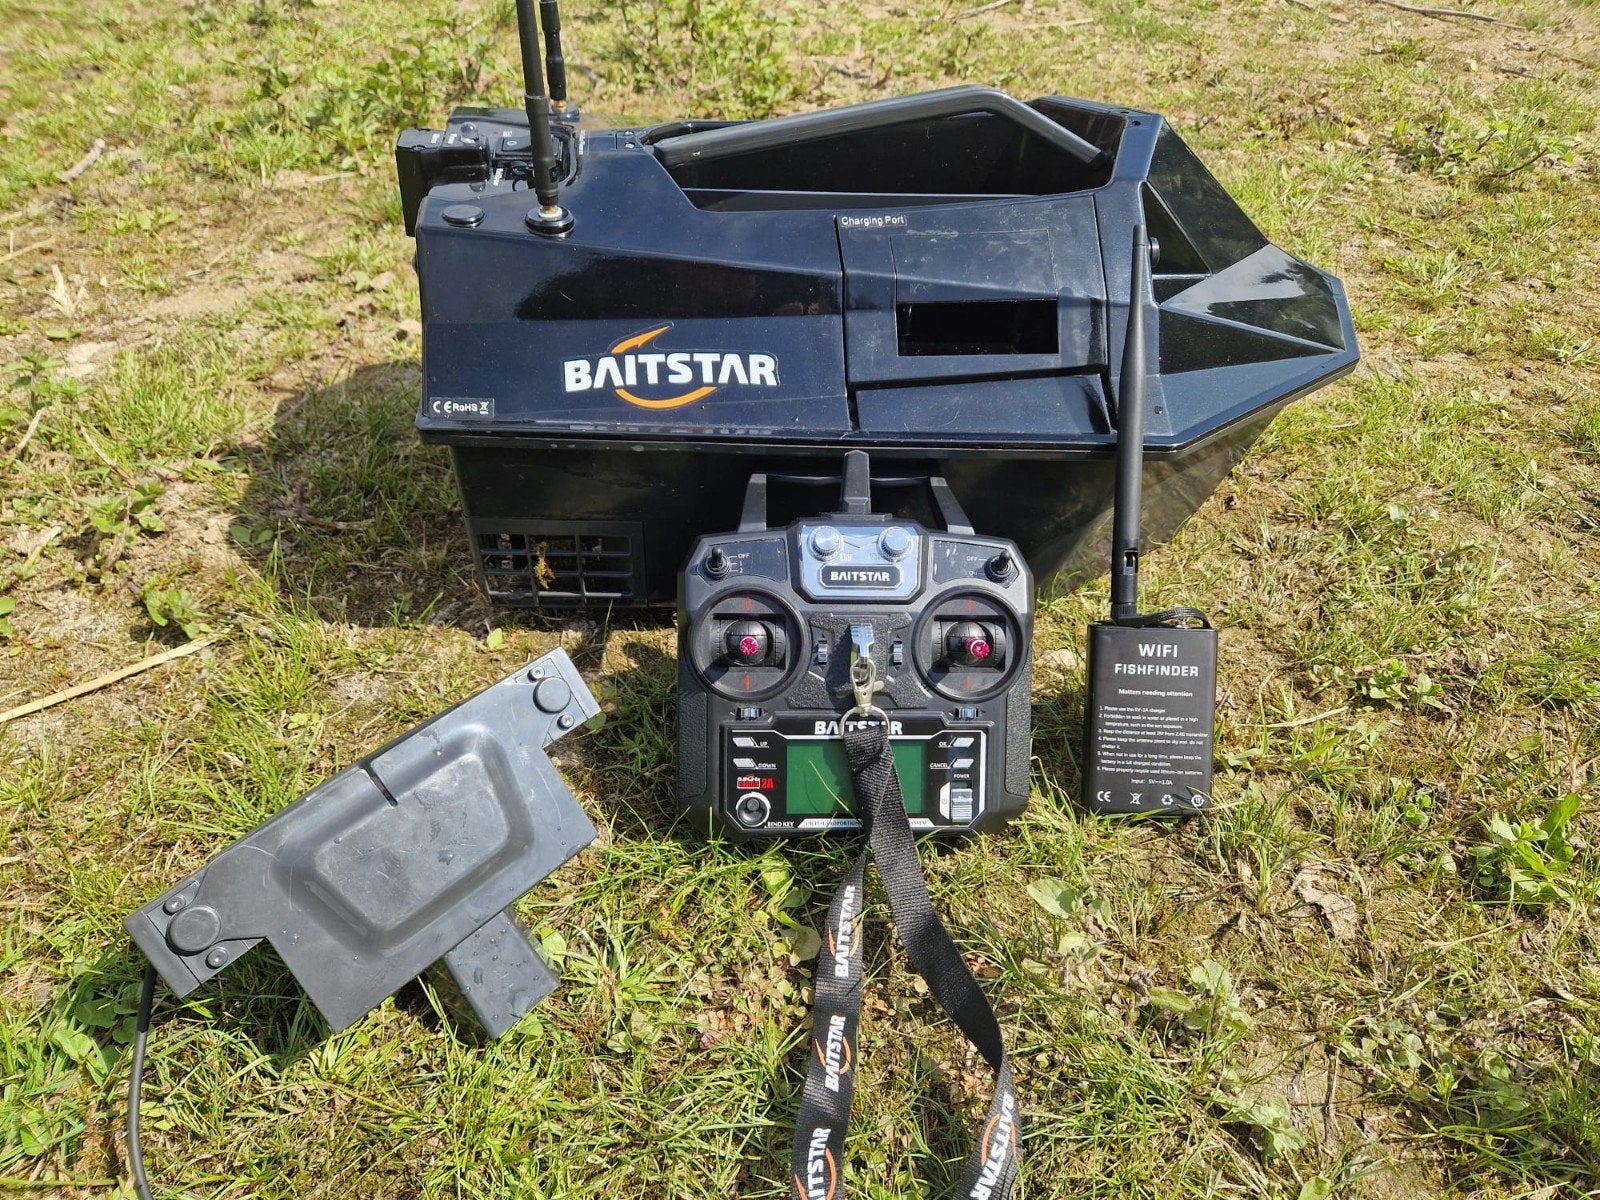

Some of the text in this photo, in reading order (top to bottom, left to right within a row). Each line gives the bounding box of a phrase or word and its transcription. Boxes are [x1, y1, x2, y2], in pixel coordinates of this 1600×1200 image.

[841, 215, 905, 227] Charging Port
[564, 352, 779, 393] BAITSTAR
[432, 400, 478, 414] CE RoHS
[737, 552, 750, 560] OFF
[966, 555, 979, 563] OFF
[829, 571, 891, 582] BAITSTAR
[1138, 643, 1178, 658] WIFI
[1114, 663, 1199, 677] FISHFINDER
[1118, 688, 1141, 696] Matters
[1142, 689, 1166, 698] needing
[1097, 790, 1112, 802] CE
[834, 885, 856, 978] BAITSTAR
[825, 1014, 846, 1093] BAITSTAR
